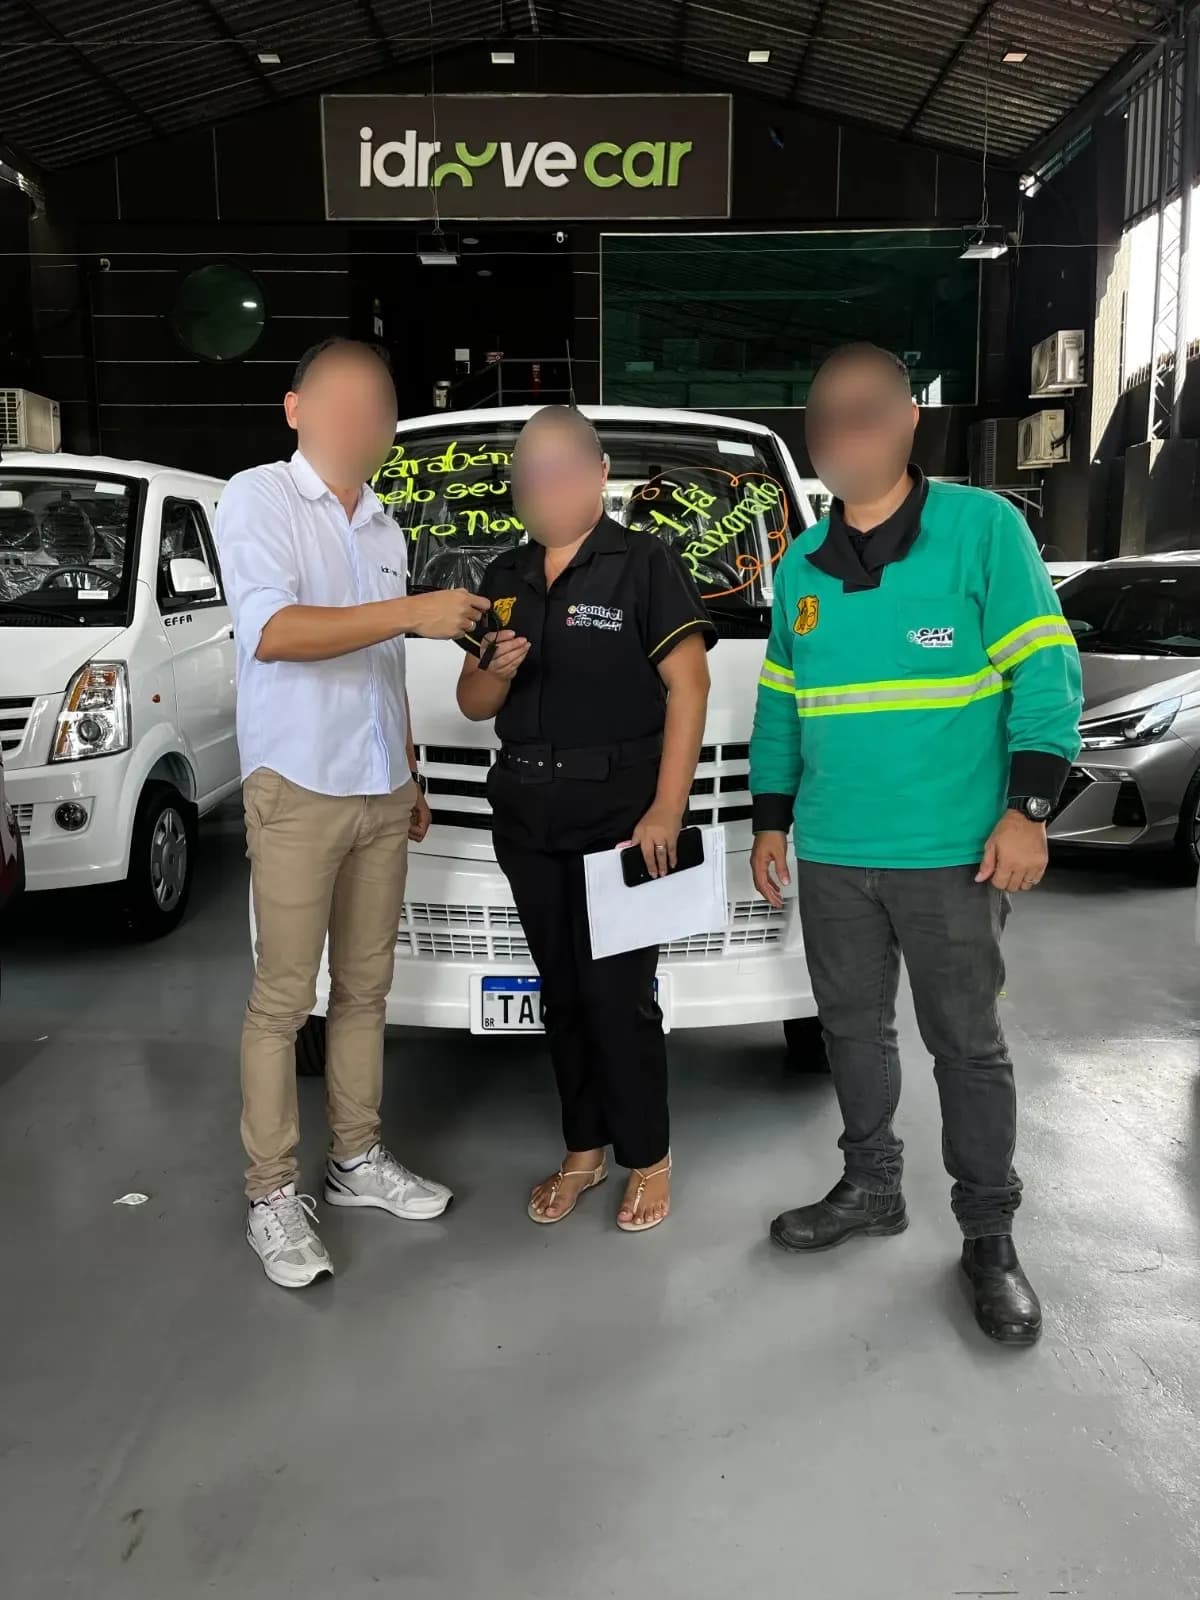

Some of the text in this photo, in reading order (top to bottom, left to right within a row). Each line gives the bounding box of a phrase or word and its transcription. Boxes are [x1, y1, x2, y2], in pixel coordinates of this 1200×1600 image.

[583, 141, 693, 188] car
[371, 441, 515, 486] Parabén
[164, 614, 193, 627] EFFA
[484, 1017, 495, 1028] BR
